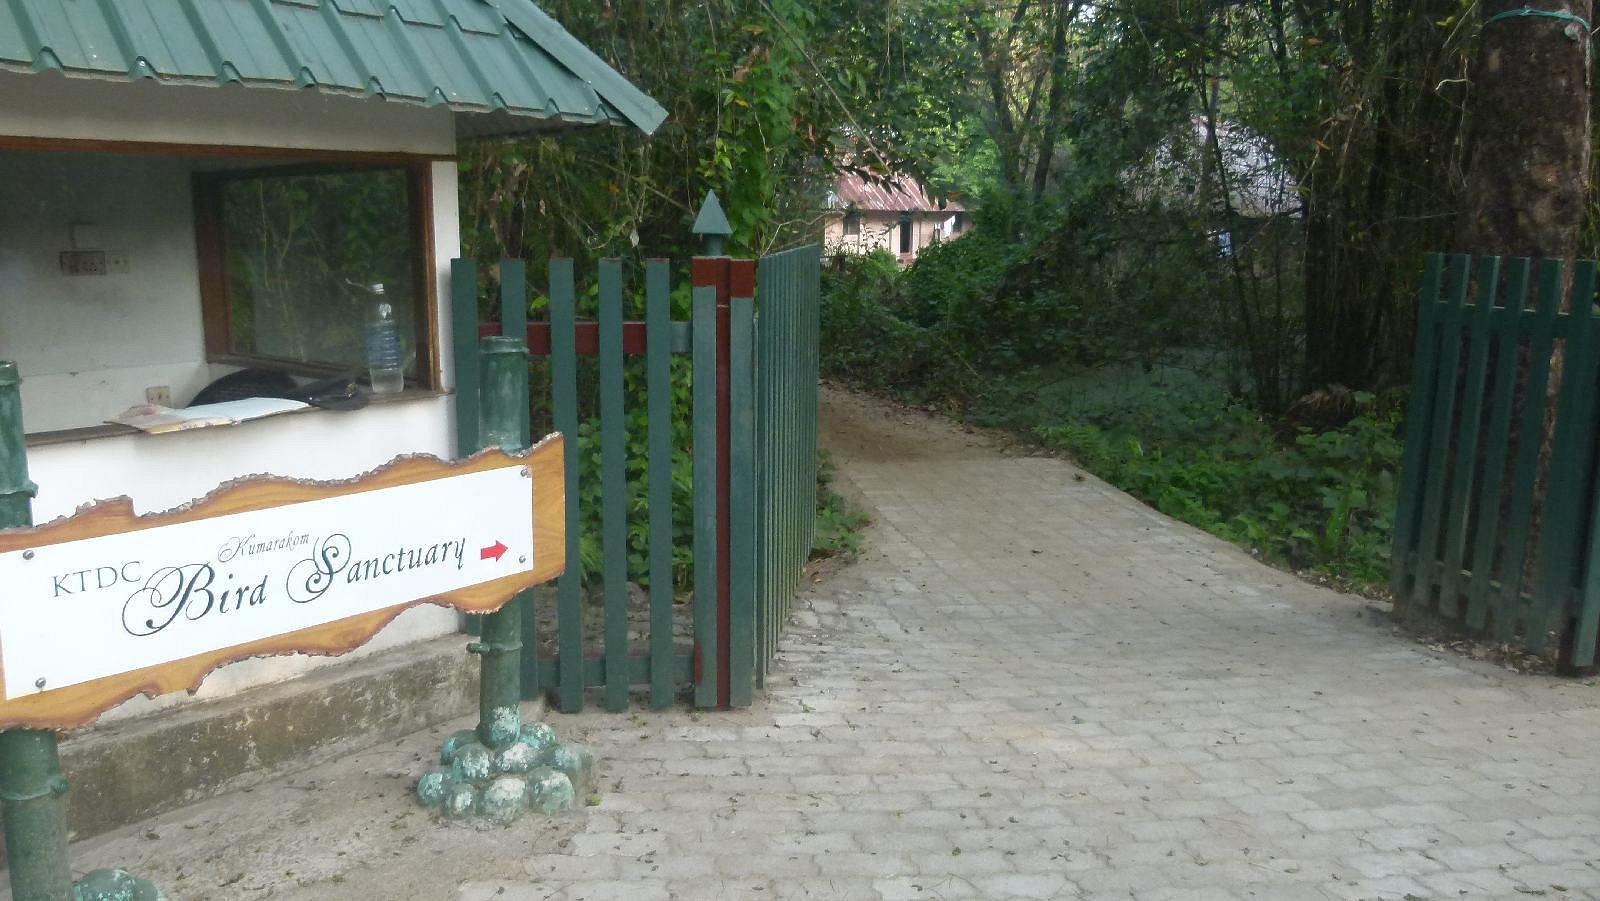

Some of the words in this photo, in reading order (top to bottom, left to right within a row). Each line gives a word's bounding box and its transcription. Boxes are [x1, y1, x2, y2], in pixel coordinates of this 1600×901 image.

[218, 531, 310, 563] Kumarakom
[52, 561, 142, 597] KTDC
[122, 563, 267, 636] Bird
[286, 533, 466, 604] Sanctuary
